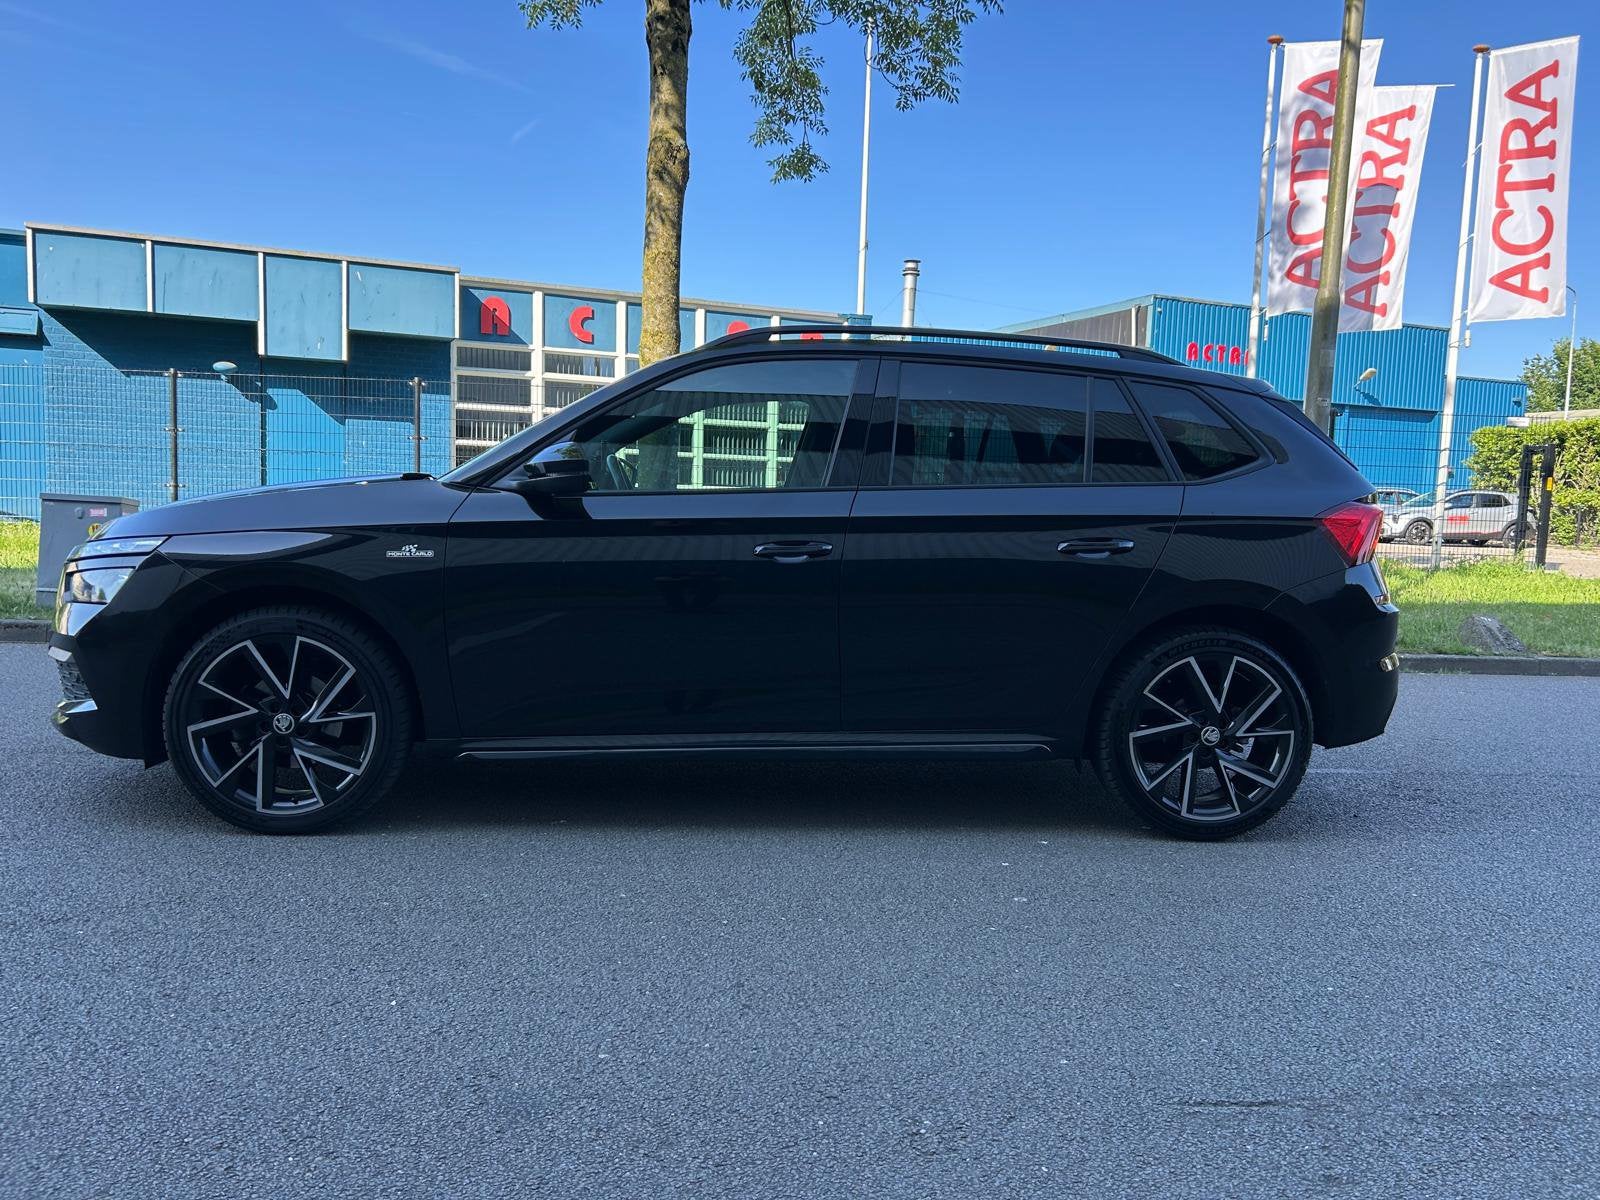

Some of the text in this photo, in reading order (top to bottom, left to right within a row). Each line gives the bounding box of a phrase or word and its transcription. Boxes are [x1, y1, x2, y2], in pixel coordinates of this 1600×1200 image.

[1285, 69, 1339, 289] ACTRA
[1344, 104, 1417, 318] ACTRA
[1488, 58, 1560, 304] ACTRA
